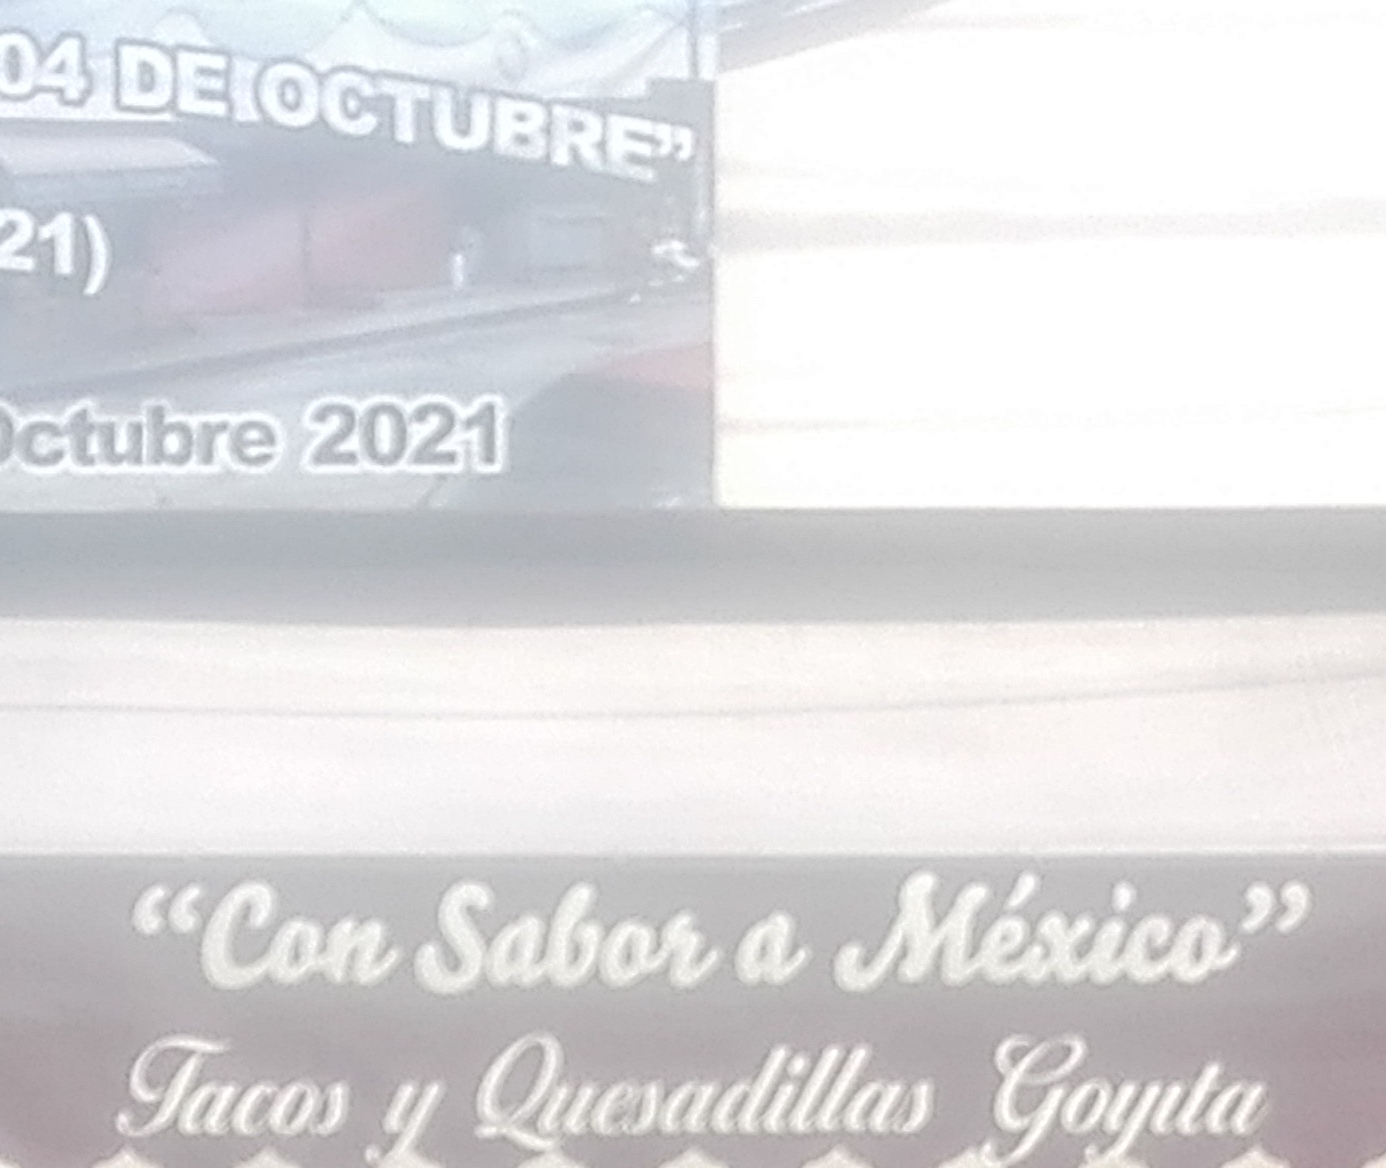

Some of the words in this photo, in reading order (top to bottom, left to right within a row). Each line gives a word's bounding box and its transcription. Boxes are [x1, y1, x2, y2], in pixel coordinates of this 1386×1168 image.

[115, 38, 230, 118] DE
[300, 391, 509, 474] 2021
[416, 878, 719, 995] Sabor
[734, 910, 810, 986] a
[116, 1032, 351, 1138] Tacos
[474, 1030, 934, 1153] Quesadillas
